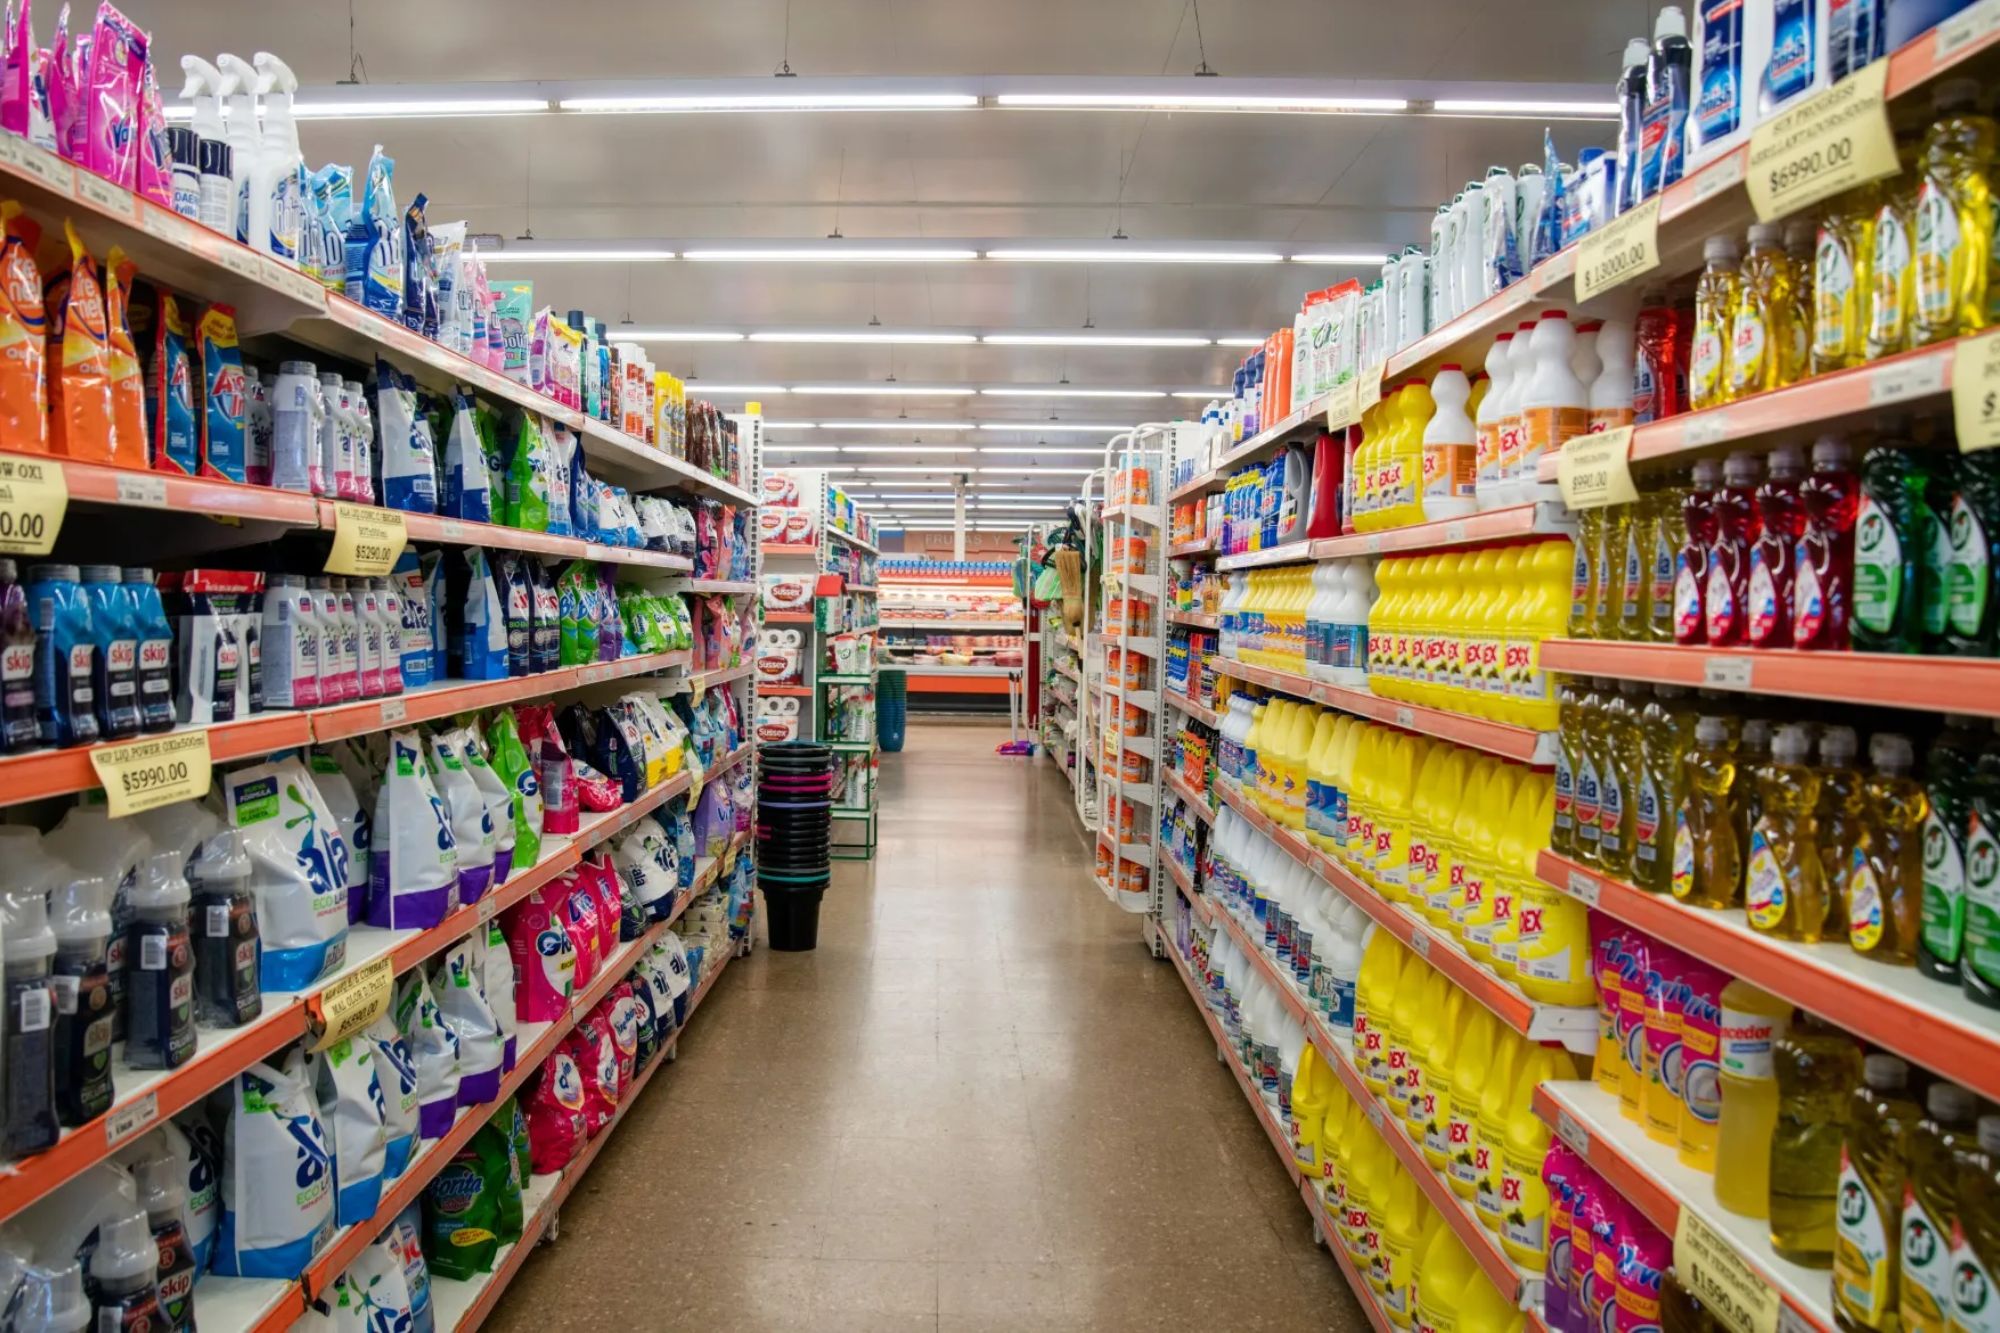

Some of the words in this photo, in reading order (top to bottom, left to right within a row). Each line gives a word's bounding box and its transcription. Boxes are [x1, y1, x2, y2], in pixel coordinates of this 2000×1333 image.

[1769, 136, 1852, 193] $6990.00
[924, 532, 982, 546] FRUAS
[355, 546, 392, 562] $5290.00
[6, 650, 32, 673] skip
[142, 643, 169, 663] skip
[122, 761, 188, 792] $5990.00
[312, 897, 334, 911] ECO
[295, 1189, 322, 1206] ECO
[159, 1274, 191, 1301] skip
